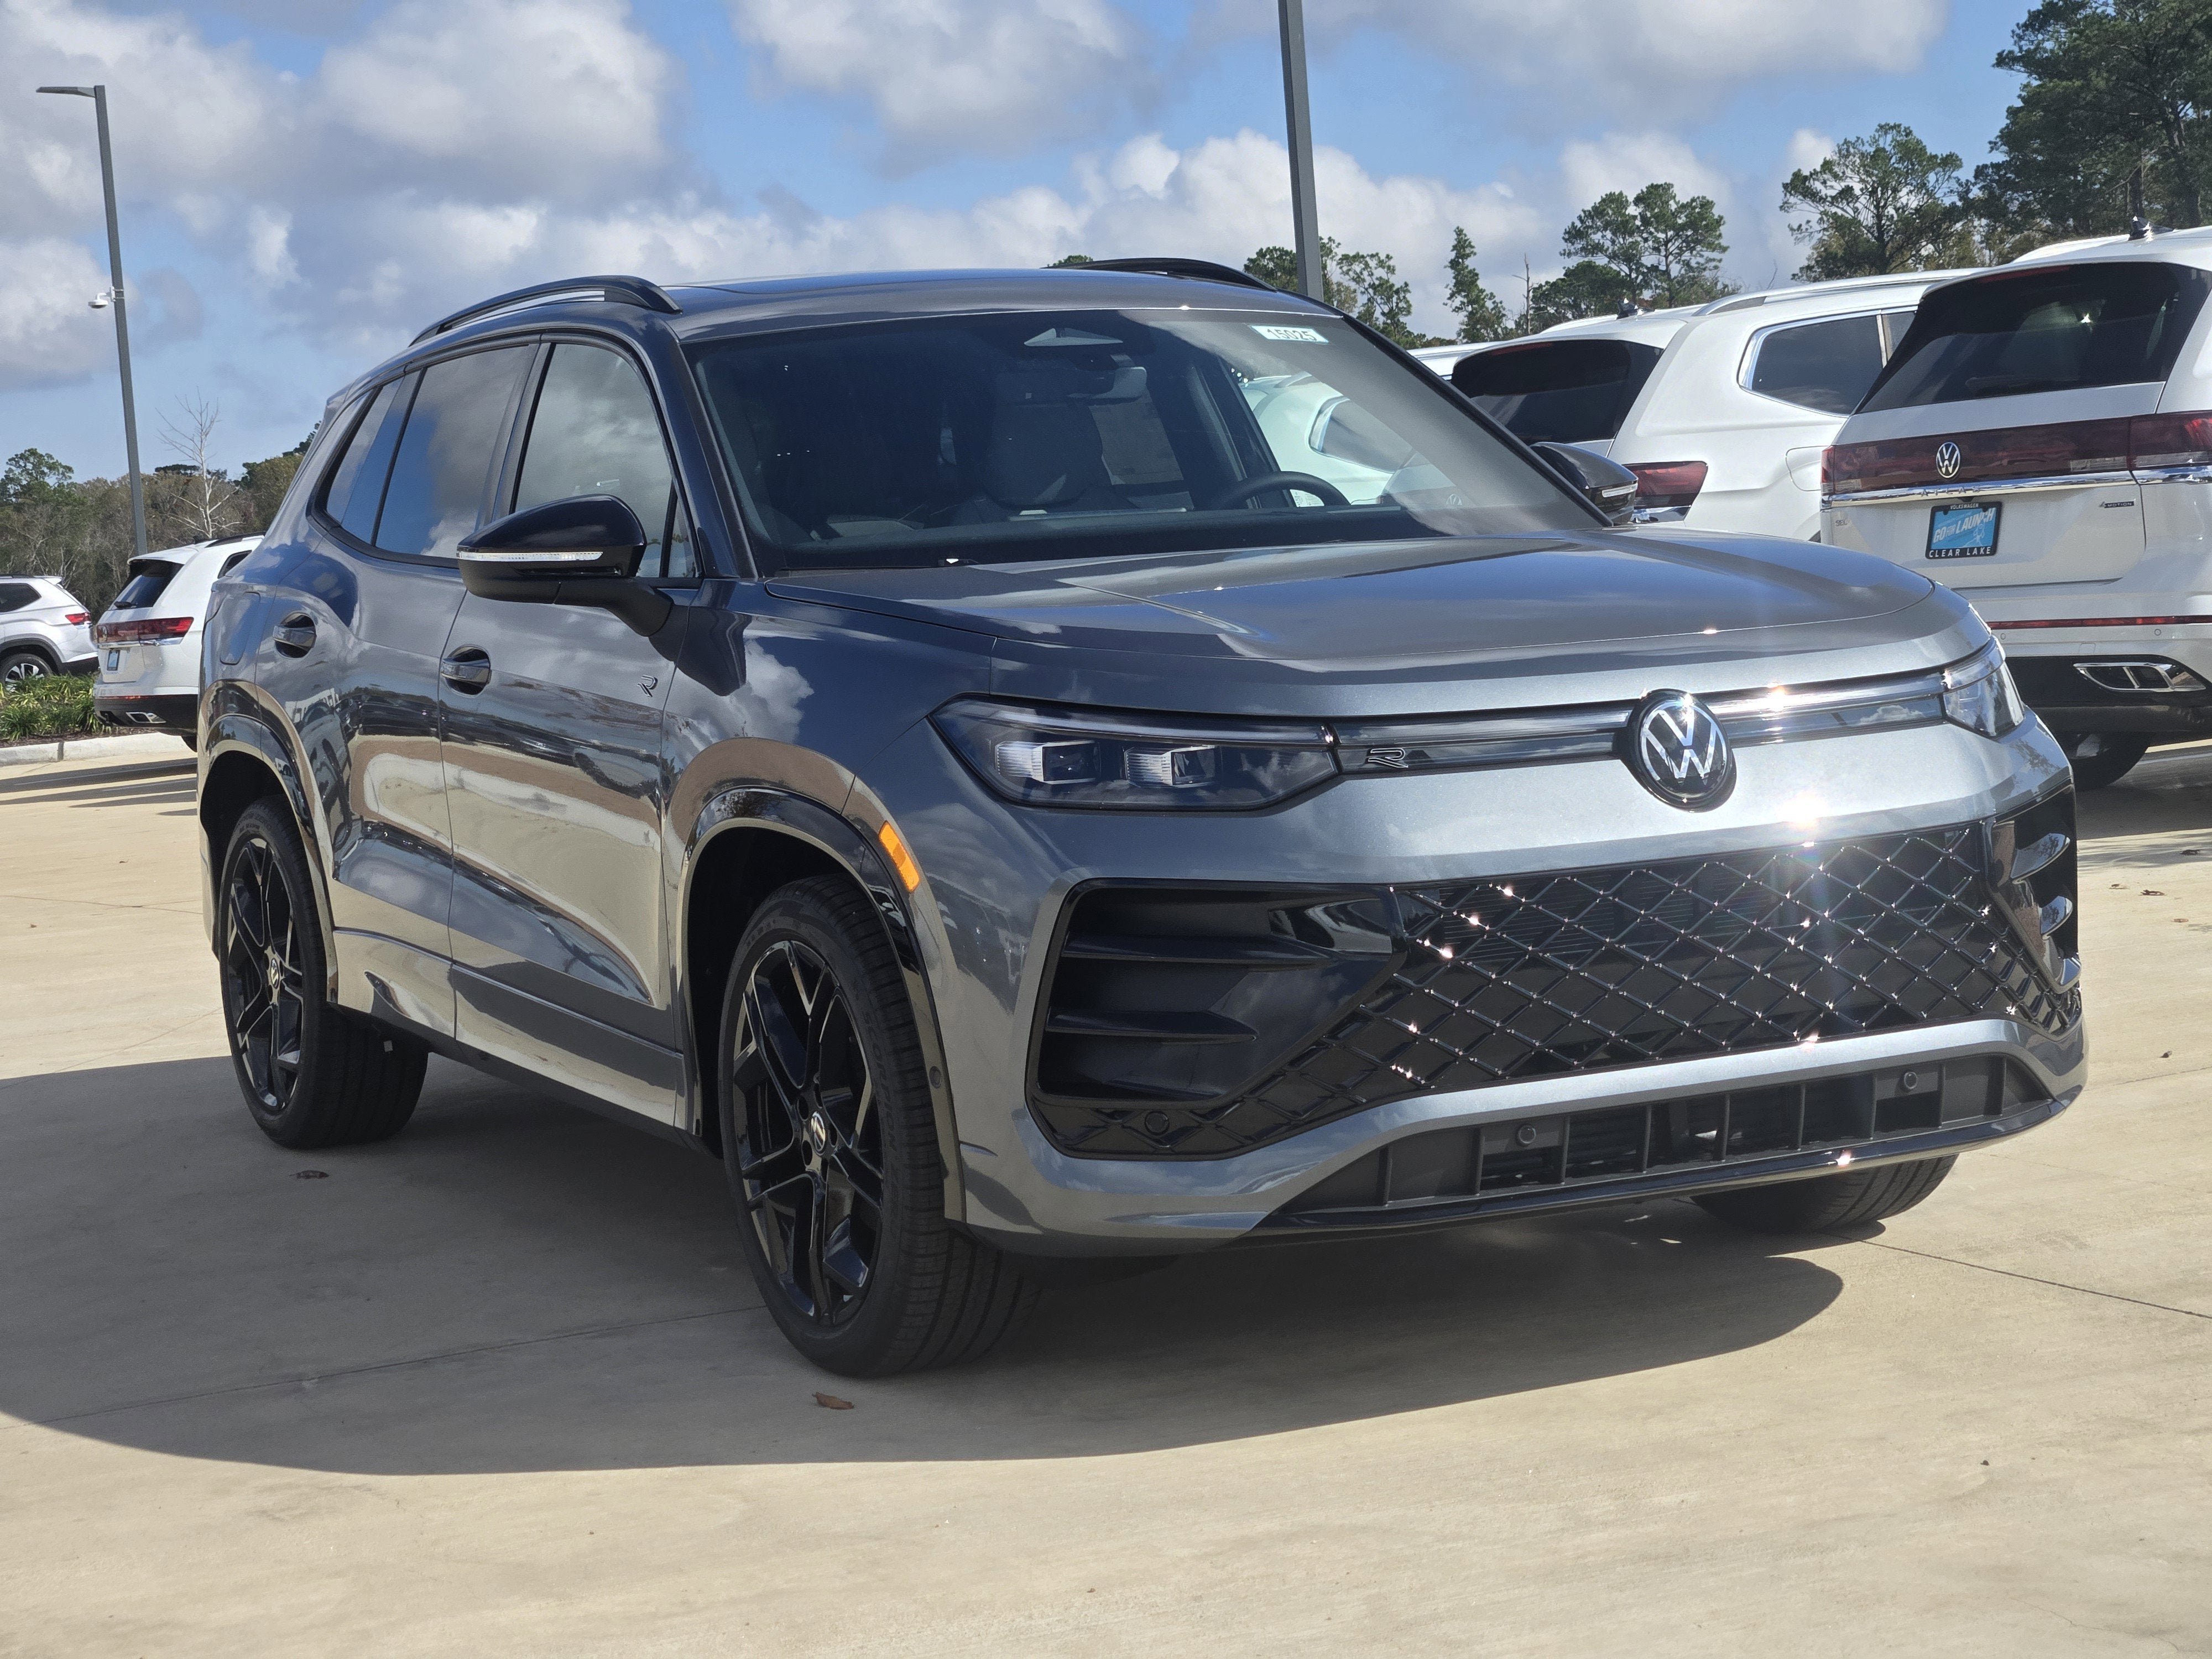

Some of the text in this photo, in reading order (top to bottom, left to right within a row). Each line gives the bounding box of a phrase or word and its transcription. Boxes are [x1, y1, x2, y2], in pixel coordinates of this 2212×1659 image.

[1266, 327, 1317, 341] 15025
[1921, 486, 1980, 497] ATLAS
[1933, 526, 1947, 543] GO
[1929, 546, 1991, 558] CLEAR LAKE
[1368, 748, 1408, 768] R
